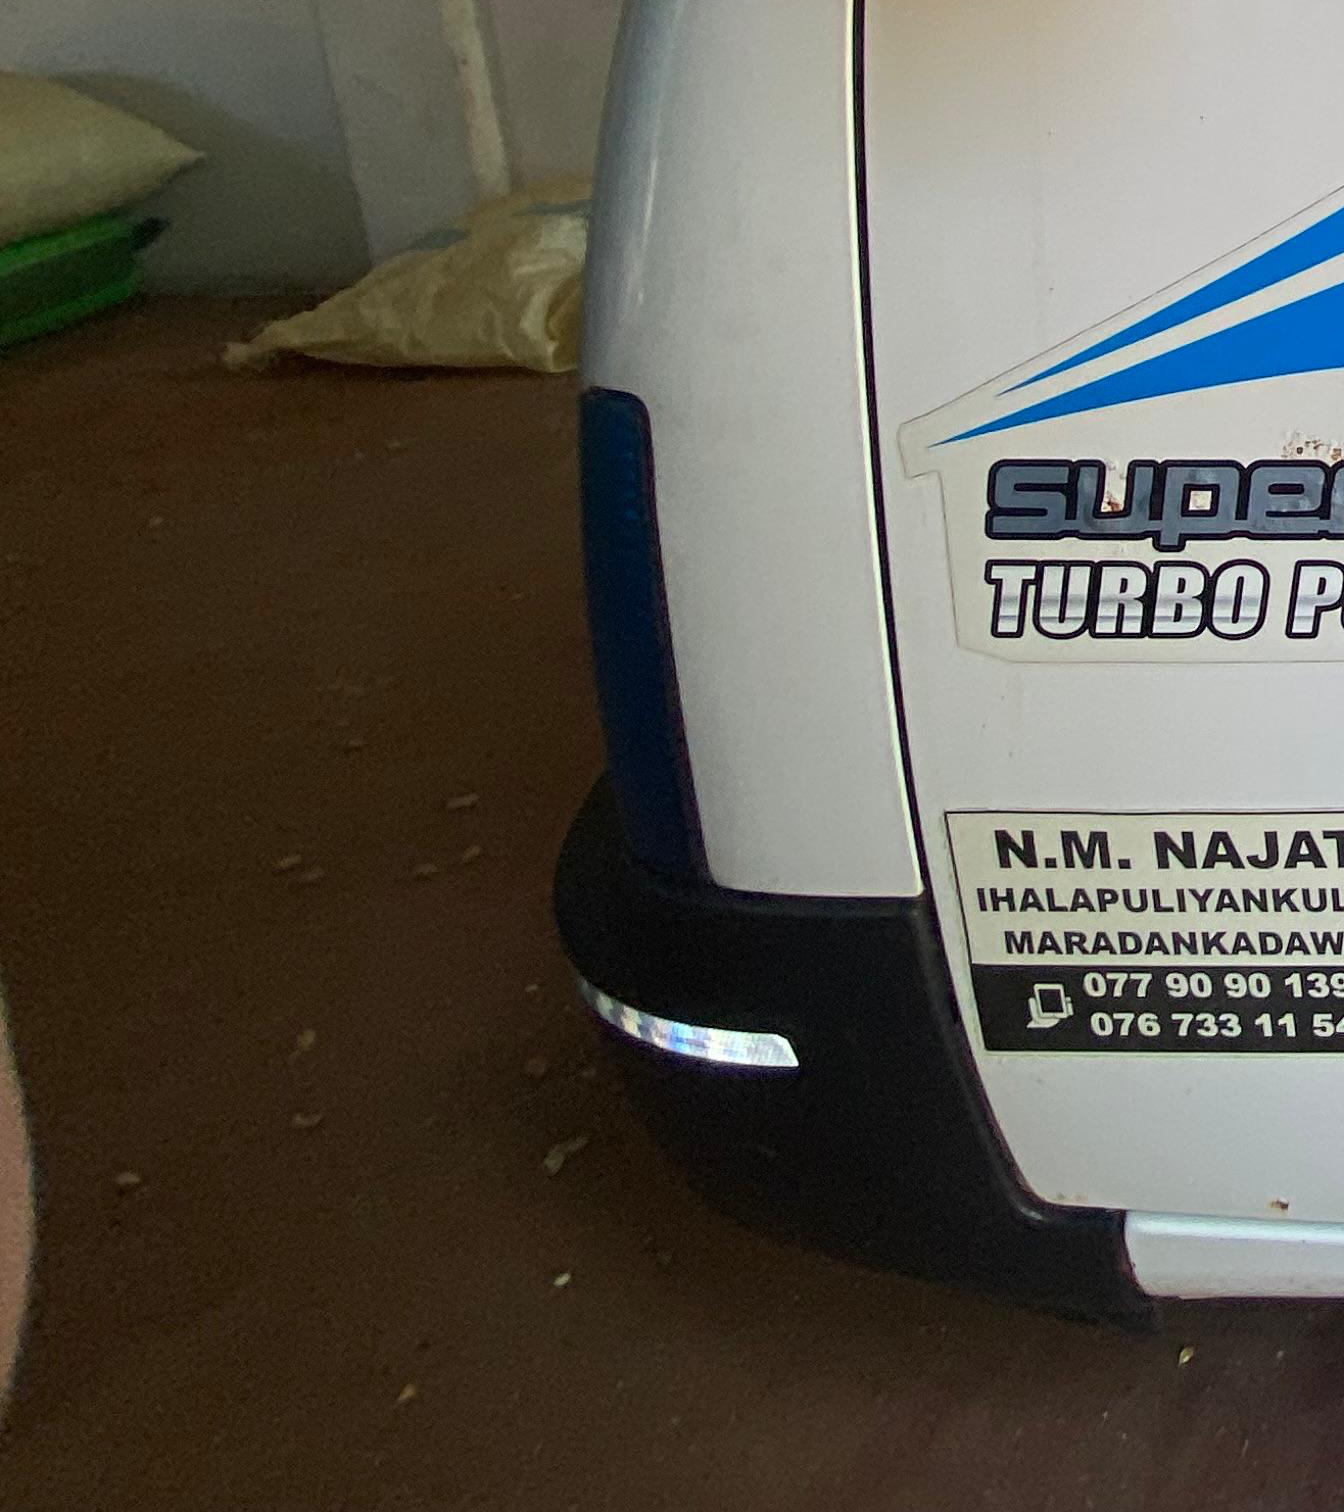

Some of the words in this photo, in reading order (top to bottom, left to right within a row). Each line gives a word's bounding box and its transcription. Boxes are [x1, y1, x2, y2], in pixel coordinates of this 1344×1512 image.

[984, 558, 1271, 641] TURBO
[994, 829, 1133, 871] N.M.
[1082, 972, 1153, 999] 077
[1165, 972, 1213, 999] 90
[1224, 972, 1272, 999] 90
[1090, 1013, 1162, 1039] 076
[1173, 1013, 1243, 1039] 733
[1254, 1013, 1297, 1038] 11
